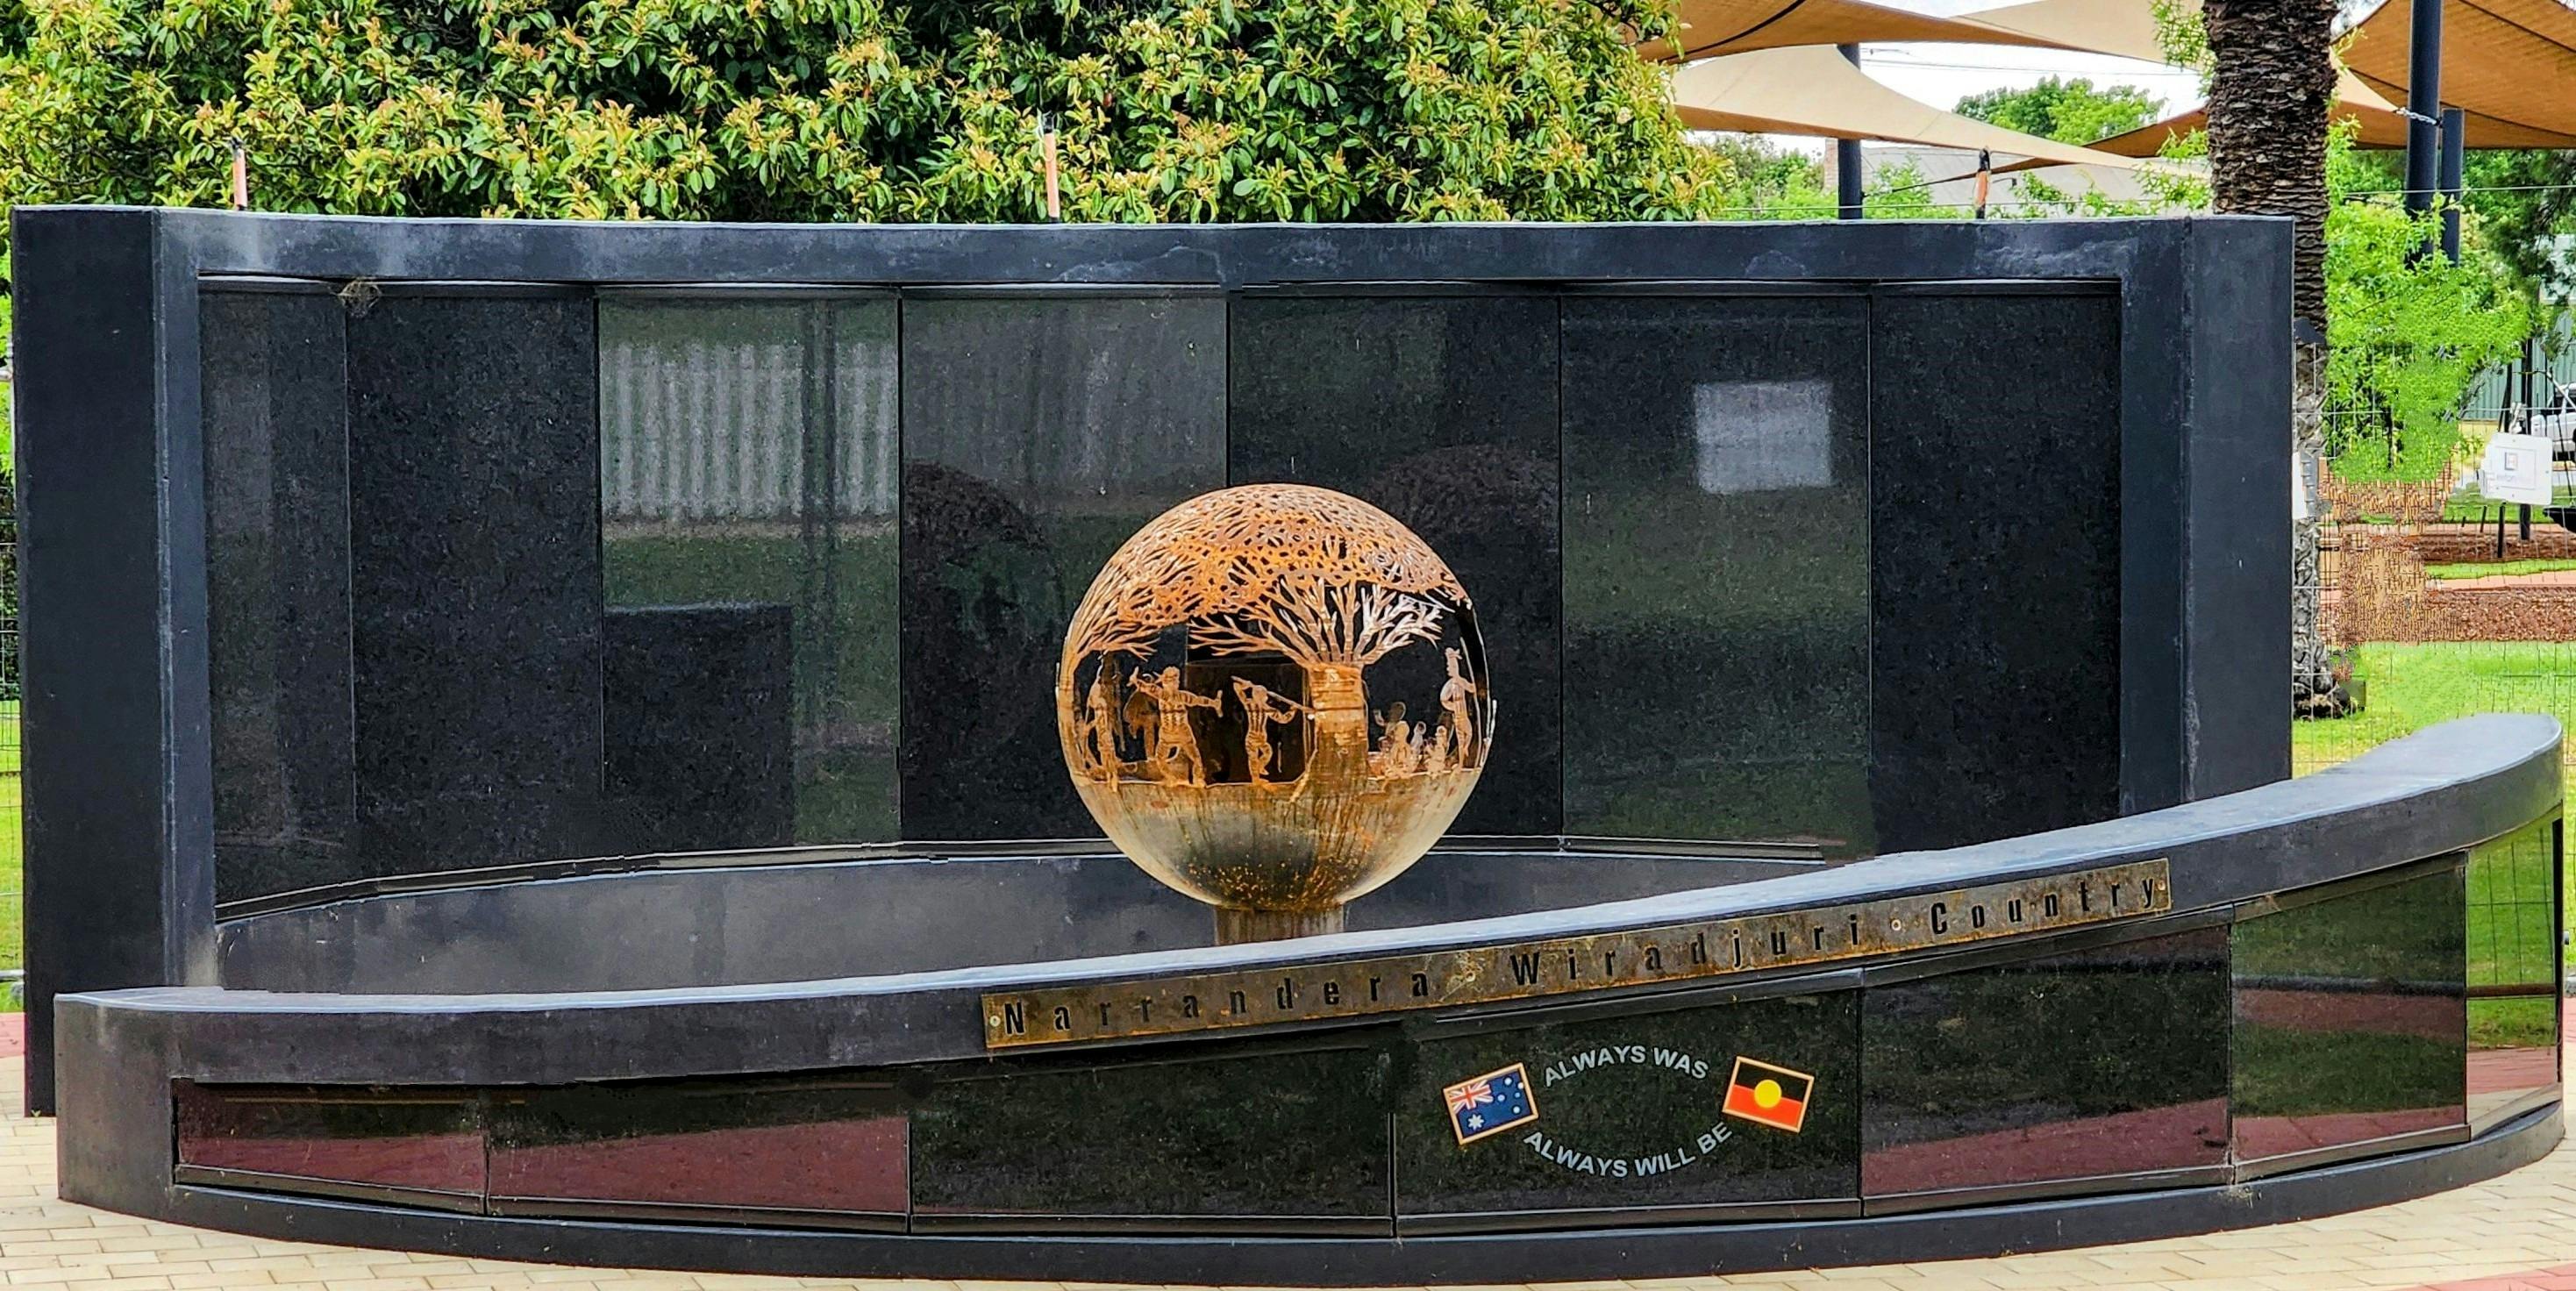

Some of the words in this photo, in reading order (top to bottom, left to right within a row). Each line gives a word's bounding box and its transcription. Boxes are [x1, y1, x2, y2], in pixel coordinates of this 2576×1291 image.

[1004, 969, 1430, 1037] Narrandera
[1509, 915, 1859, 987] Wiradjuri
[1930, 879, 2155, 937] Country
[1544, 1045, 1646, 1088] ALWAYS
[1653, 1047, 1709, 1080] WAS
[1523, 1131, 1628, 1179] ALWAYS
[1634, 1147, 1695, 1178] WILL
[1696, 1122, 1733, 1155] BE
